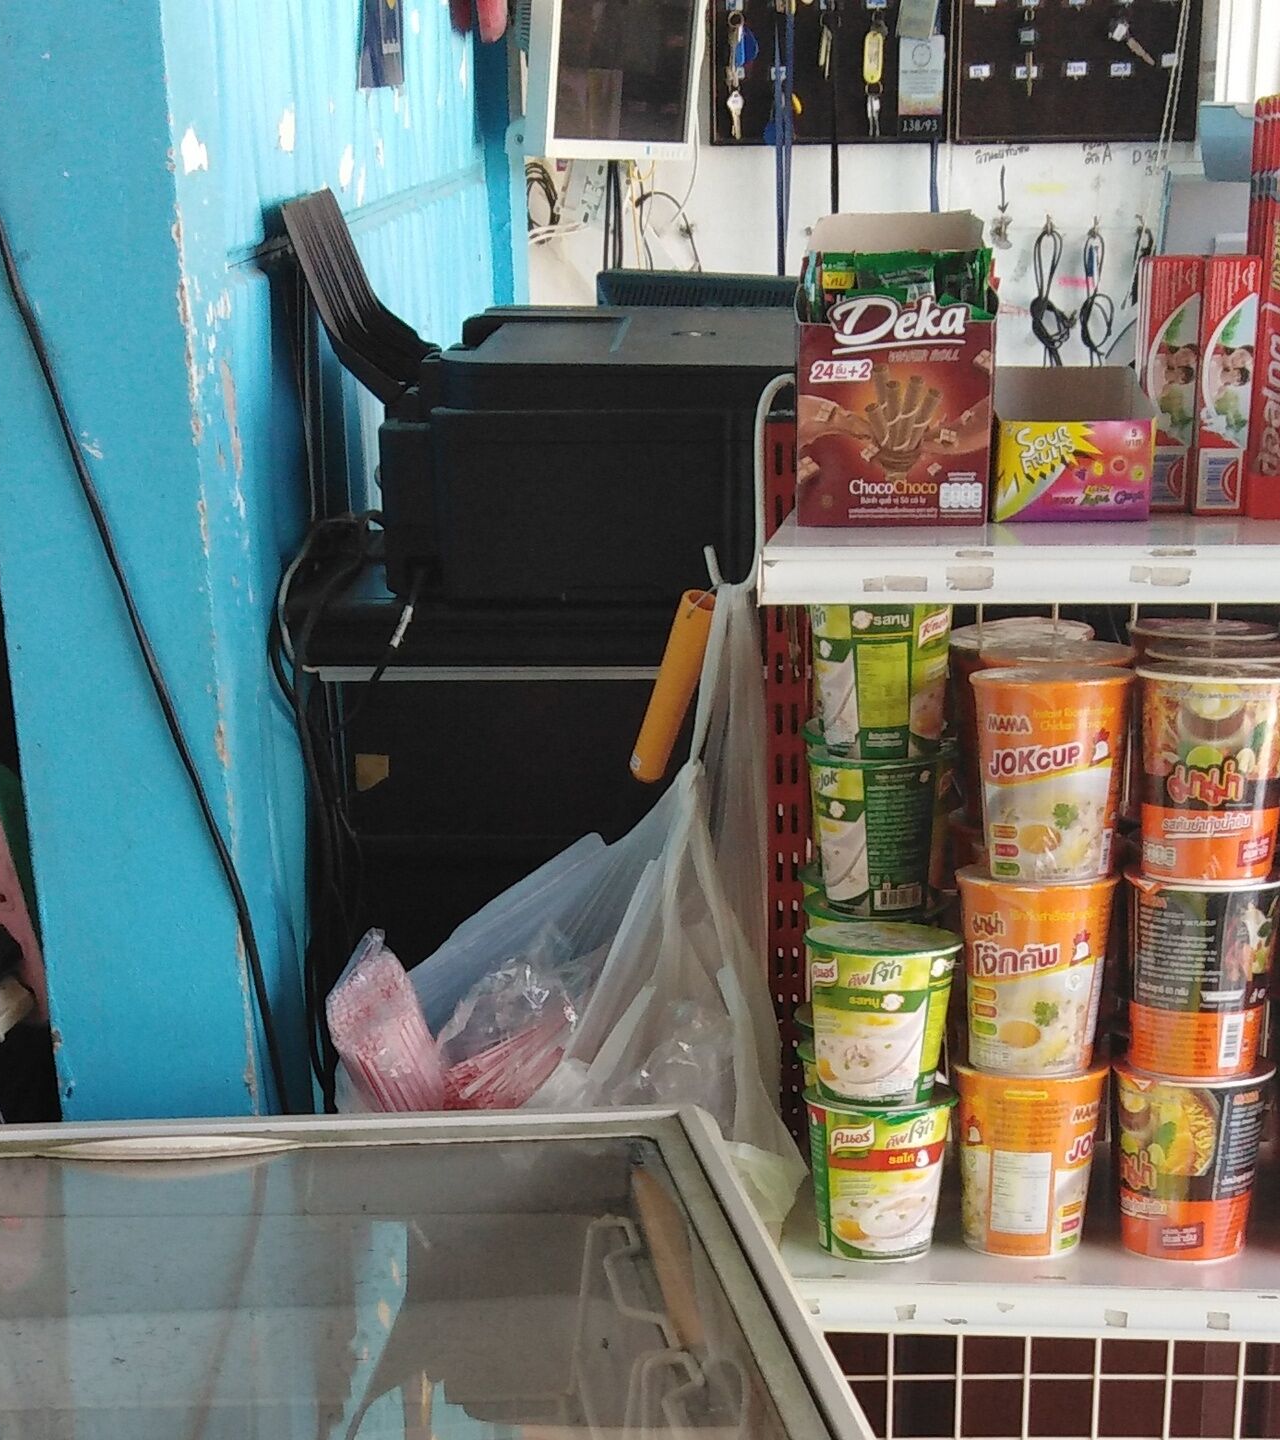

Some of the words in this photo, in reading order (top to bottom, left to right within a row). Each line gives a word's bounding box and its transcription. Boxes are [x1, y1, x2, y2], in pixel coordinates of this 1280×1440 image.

[833, 296, 967, 345] Deka
[1016, 426, 1070, 458] SOUR
[1022, 440, 1076, 474] FRUITS
[988, 714, 1032, 734] MAMA
[989, 744, 1082, 777] JOKCUP
[1167, 759, 1245, 807] มาม่า
[973, 941, 1060, 977] โจ๊กคัพ
[848, 994, 881, 1010] รสหมู
[833, 1127, 872, 1147] คนอร์
[888, 1152, 916, 1165] รสไก่
